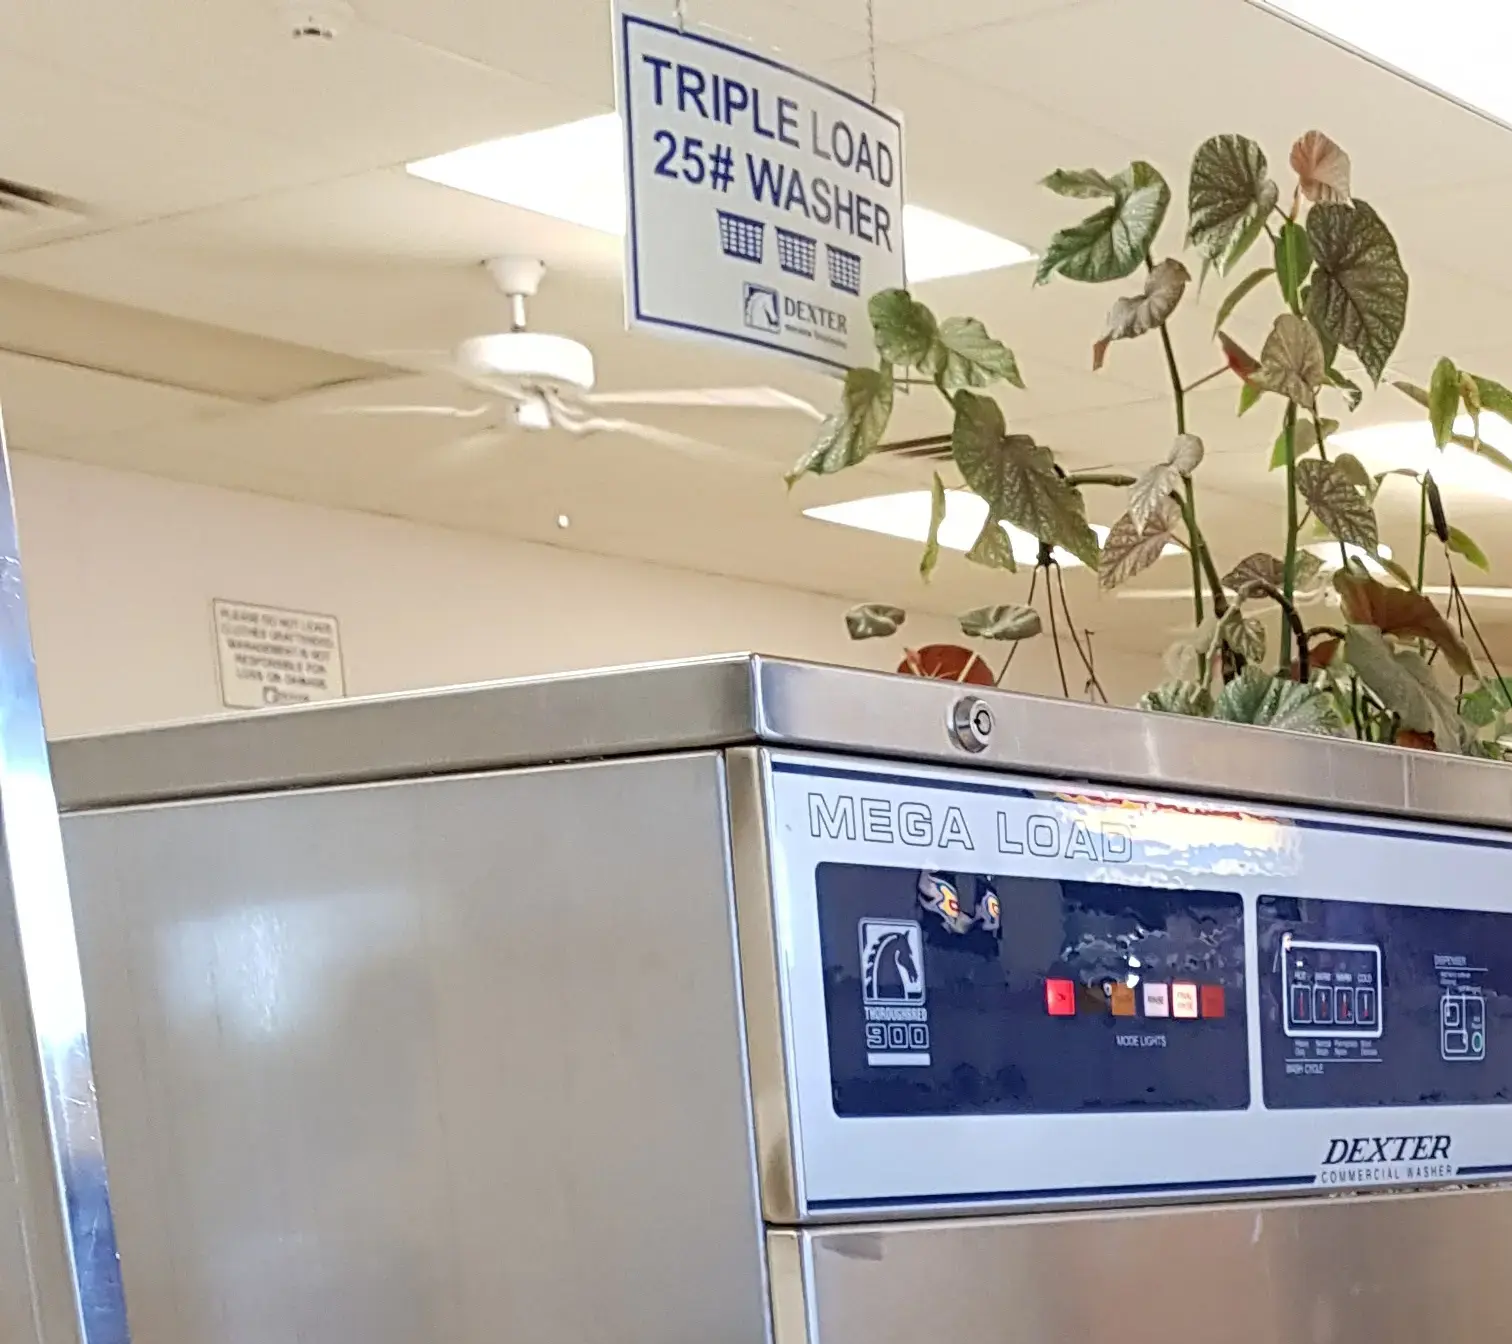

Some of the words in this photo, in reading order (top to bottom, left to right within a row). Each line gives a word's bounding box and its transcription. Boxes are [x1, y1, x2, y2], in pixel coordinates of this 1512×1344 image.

[642, 54, 800, 149] TRIPLE
[810, 109, 894, 188] LOAD
[653, 130, 735, 193] 25#
[745, 152, 893, 252] WASHER
[784, 296, 848, 333] DEXTER
[807, 792, 974, 852] MEGA
[996, 811, 1134, 863] LOAD
[865, 1023, 931, 1050] 900
[1115, 1034, 1139, 1046] MODE
[1140, 1035, 1167, 1047] LIGHTS
[1321, 1135, 1452, 1165] DEXTER
[1321, 1166, 1400, 1184] COMMERCIAL
[1407, 1164, 1453, 1179] WASHER
